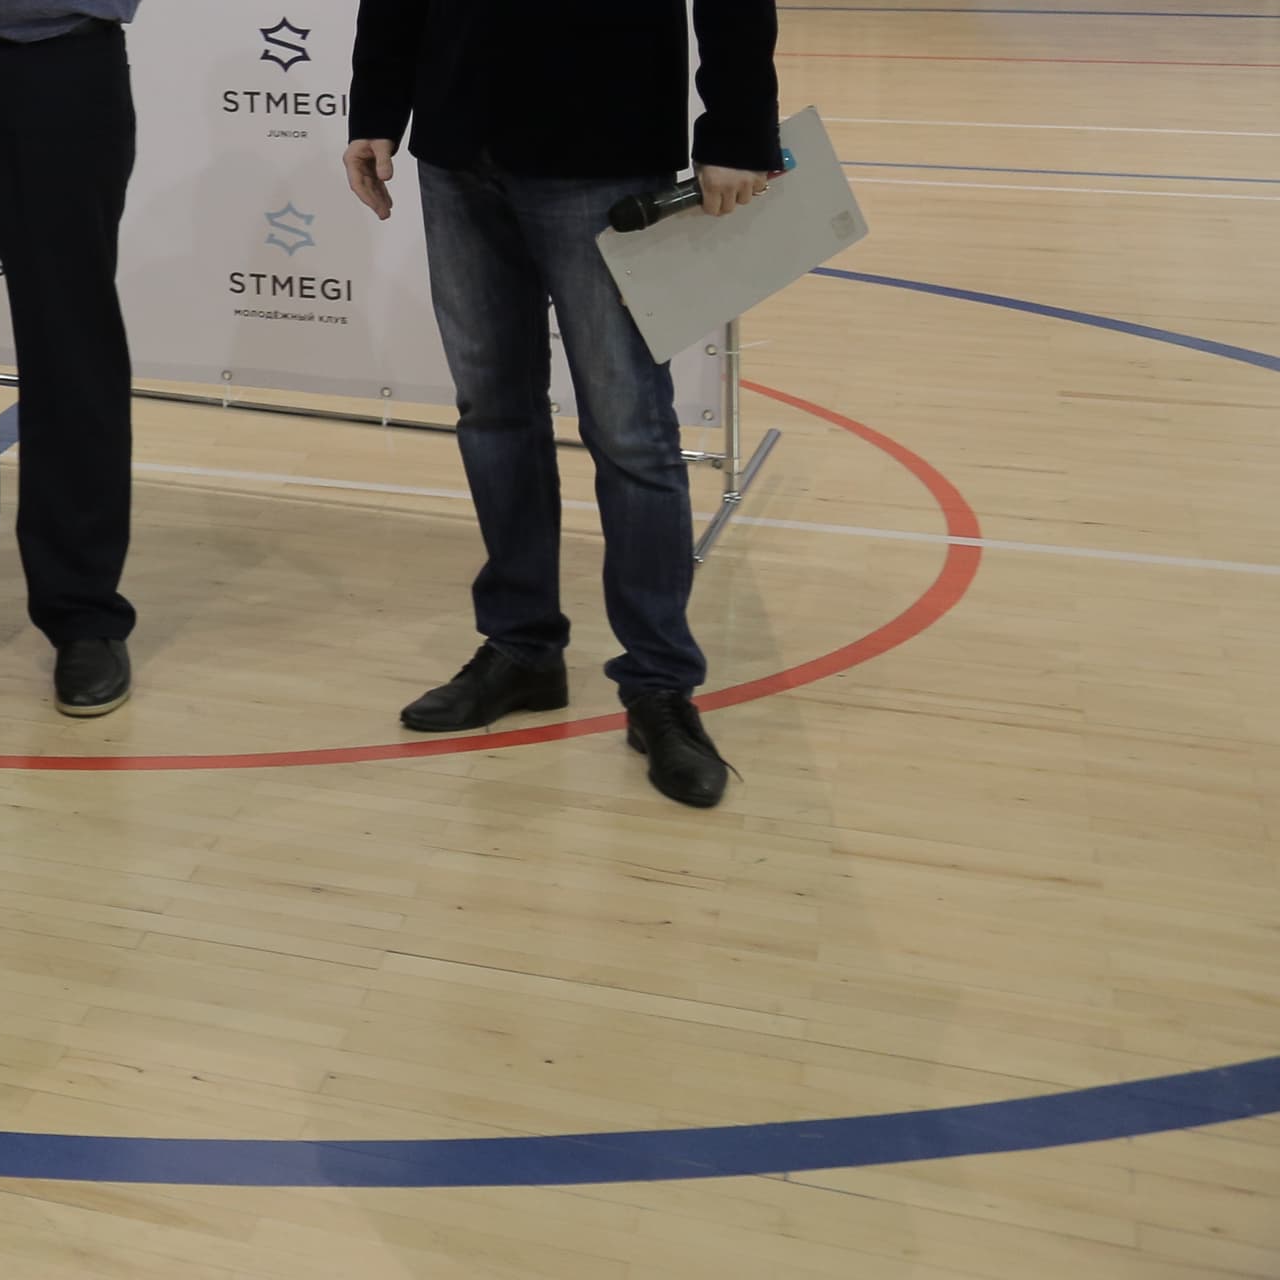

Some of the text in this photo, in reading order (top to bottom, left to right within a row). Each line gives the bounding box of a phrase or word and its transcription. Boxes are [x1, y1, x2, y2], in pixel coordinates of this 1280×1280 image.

[222, 90, 348, 116] STMEGI
[266, 130, 308, 139] JUNIOR
[229, 272, 352, 302] STMEGI
